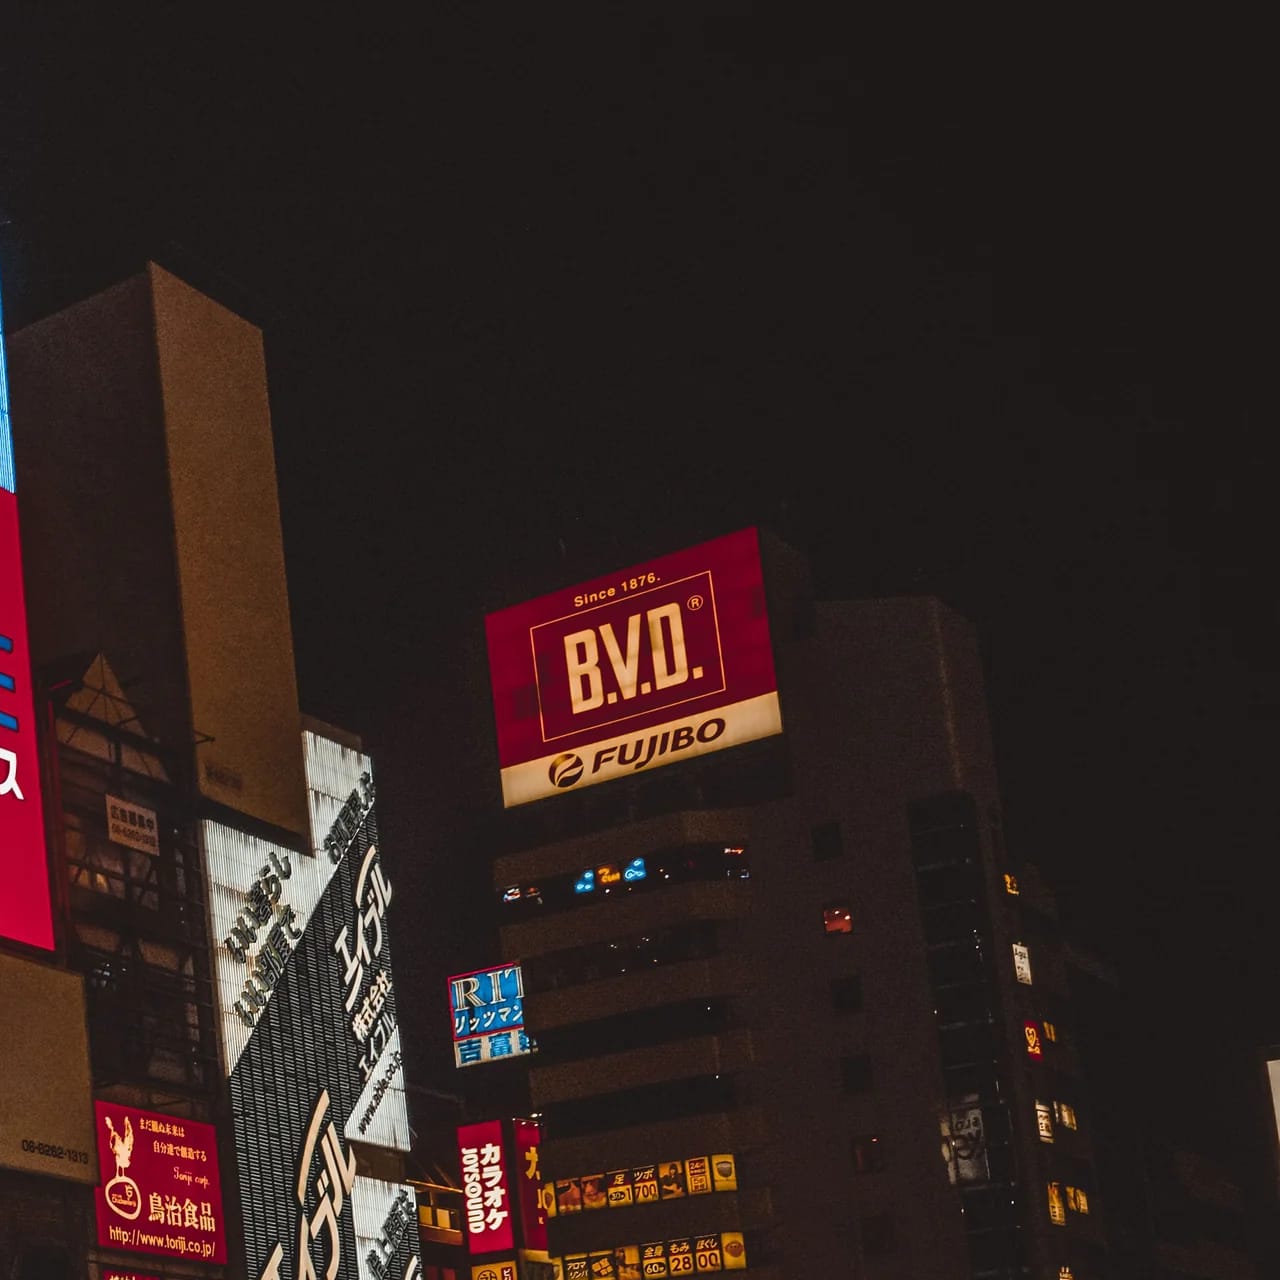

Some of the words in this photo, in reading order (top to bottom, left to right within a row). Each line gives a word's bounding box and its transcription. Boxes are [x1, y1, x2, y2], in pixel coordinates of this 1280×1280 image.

[574, 588, 617, 609] Since
[563, 601, 704, 715] B.V.D.
[592, 717, 726, 774] FUJIBO
[334, 862, 393, 987] エイブル
[148, 1192, 216, 1233] 鳥治食品
[461, 1147, 485, 1234] JOYSOUND
[480, 1143, 509, 1232] カラオケ
